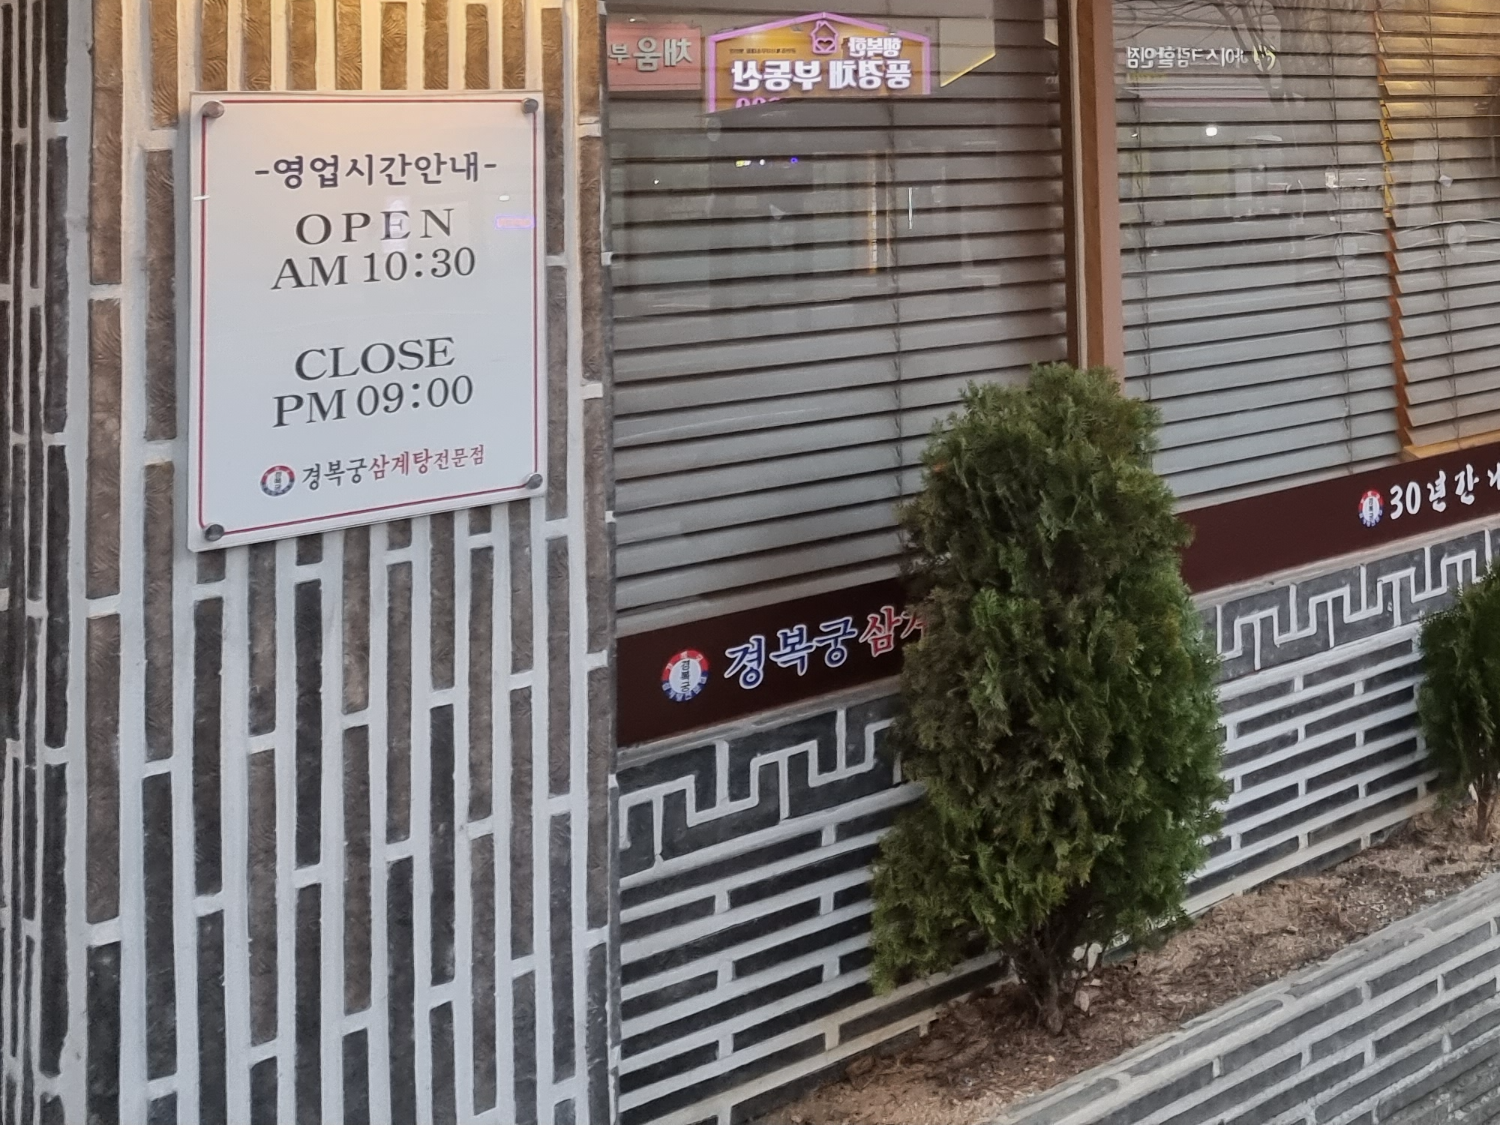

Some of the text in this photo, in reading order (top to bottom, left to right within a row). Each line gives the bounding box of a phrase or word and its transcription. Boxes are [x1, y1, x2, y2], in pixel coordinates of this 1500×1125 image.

[294, 207, 456, 246] OPEN
[269, 246, 476, 291] AM 10:30
[294, 336, 456, 382] CLOSE
[271, 374, 474, 428] PM 09:00
